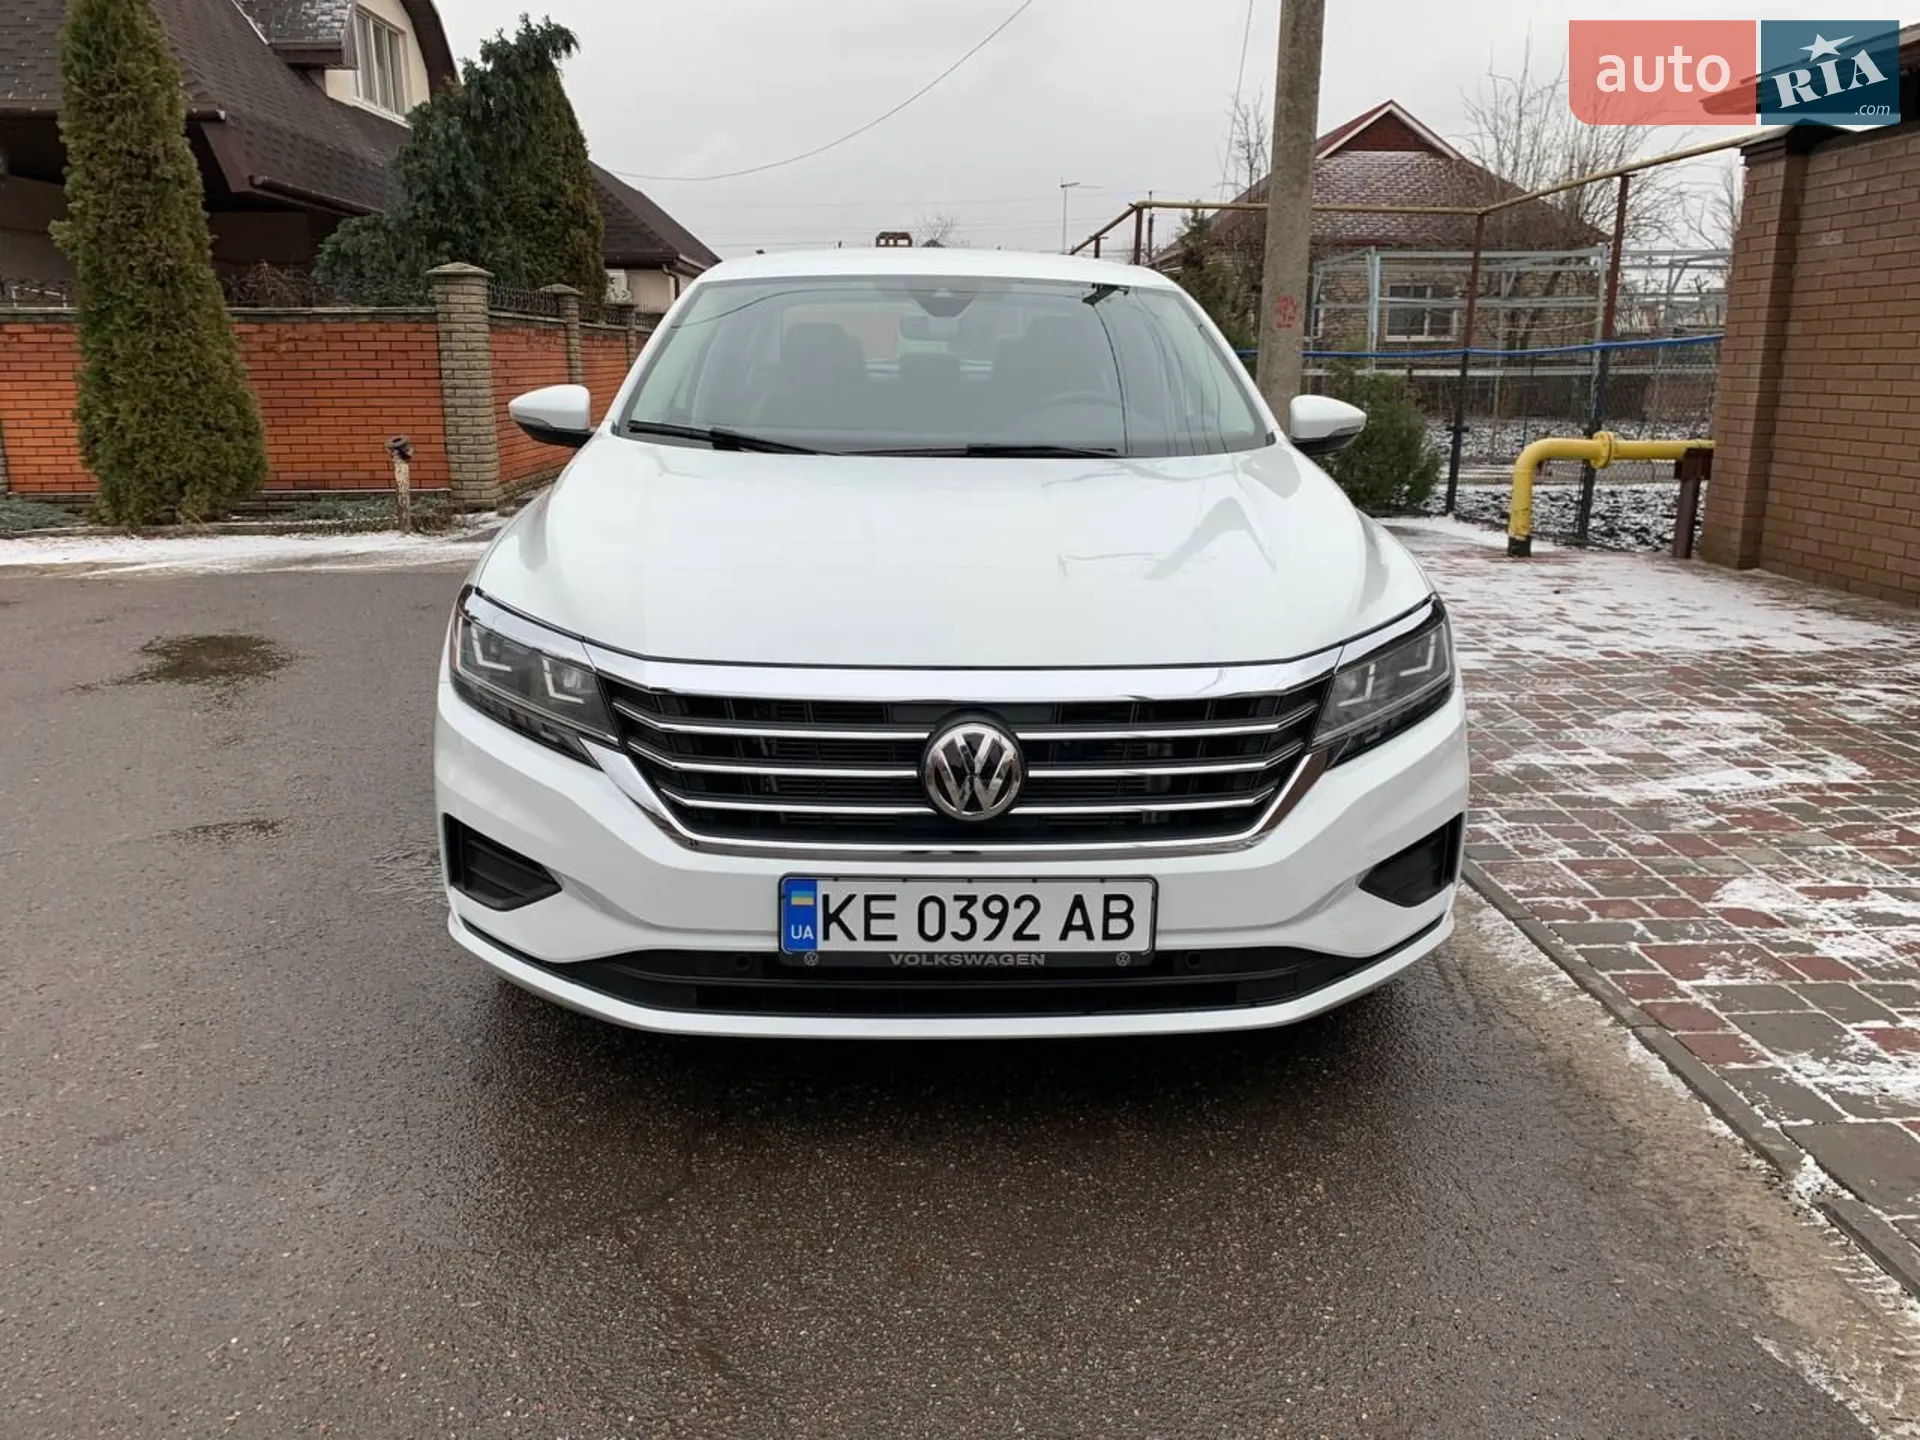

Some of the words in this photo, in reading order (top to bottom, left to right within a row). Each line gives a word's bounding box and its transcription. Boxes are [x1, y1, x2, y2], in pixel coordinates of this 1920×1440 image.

[822, 894, 898, 941] KE
[918, 894, 1042, 942] 0392
[1059, 894, 1135, 941] AB
[790, 925, 814, 941] UA
[889, 953, 1045, 966] VOLKSWAGEN
